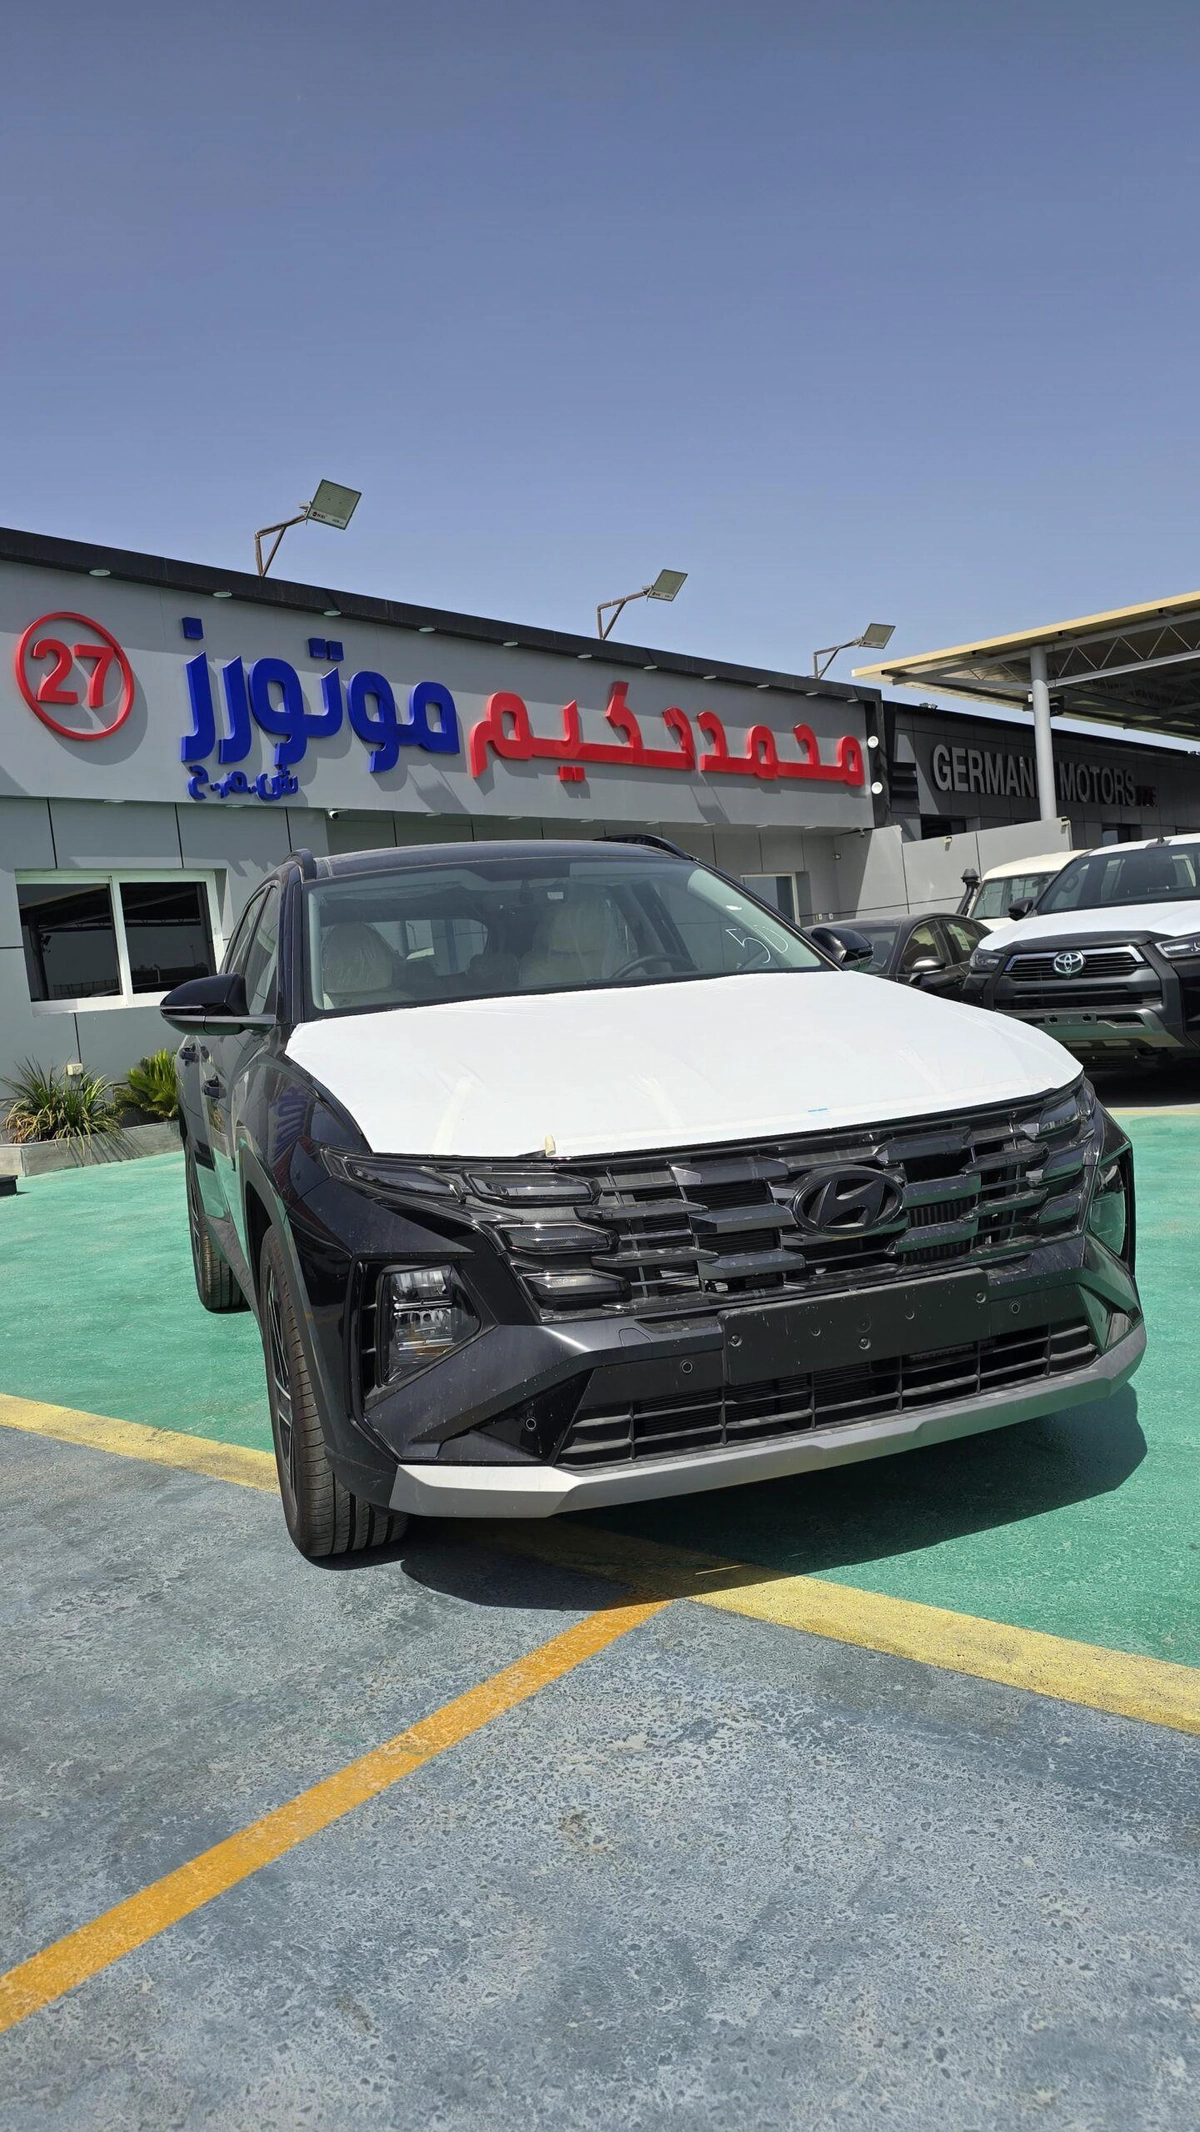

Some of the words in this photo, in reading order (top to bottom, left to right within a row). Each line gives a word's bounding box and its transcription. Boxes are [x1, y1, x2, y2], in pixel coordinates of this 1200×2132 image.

[31, 638, 114, 708] 27
[181, 617, 460, 773] موتورز
[470, 681, 697, 782] حكيم
[697, 711, 865, 786] محمد
[933, 744, 1041, 799] GERMAN
[1059, 761, 1136, 807] MOTORS
